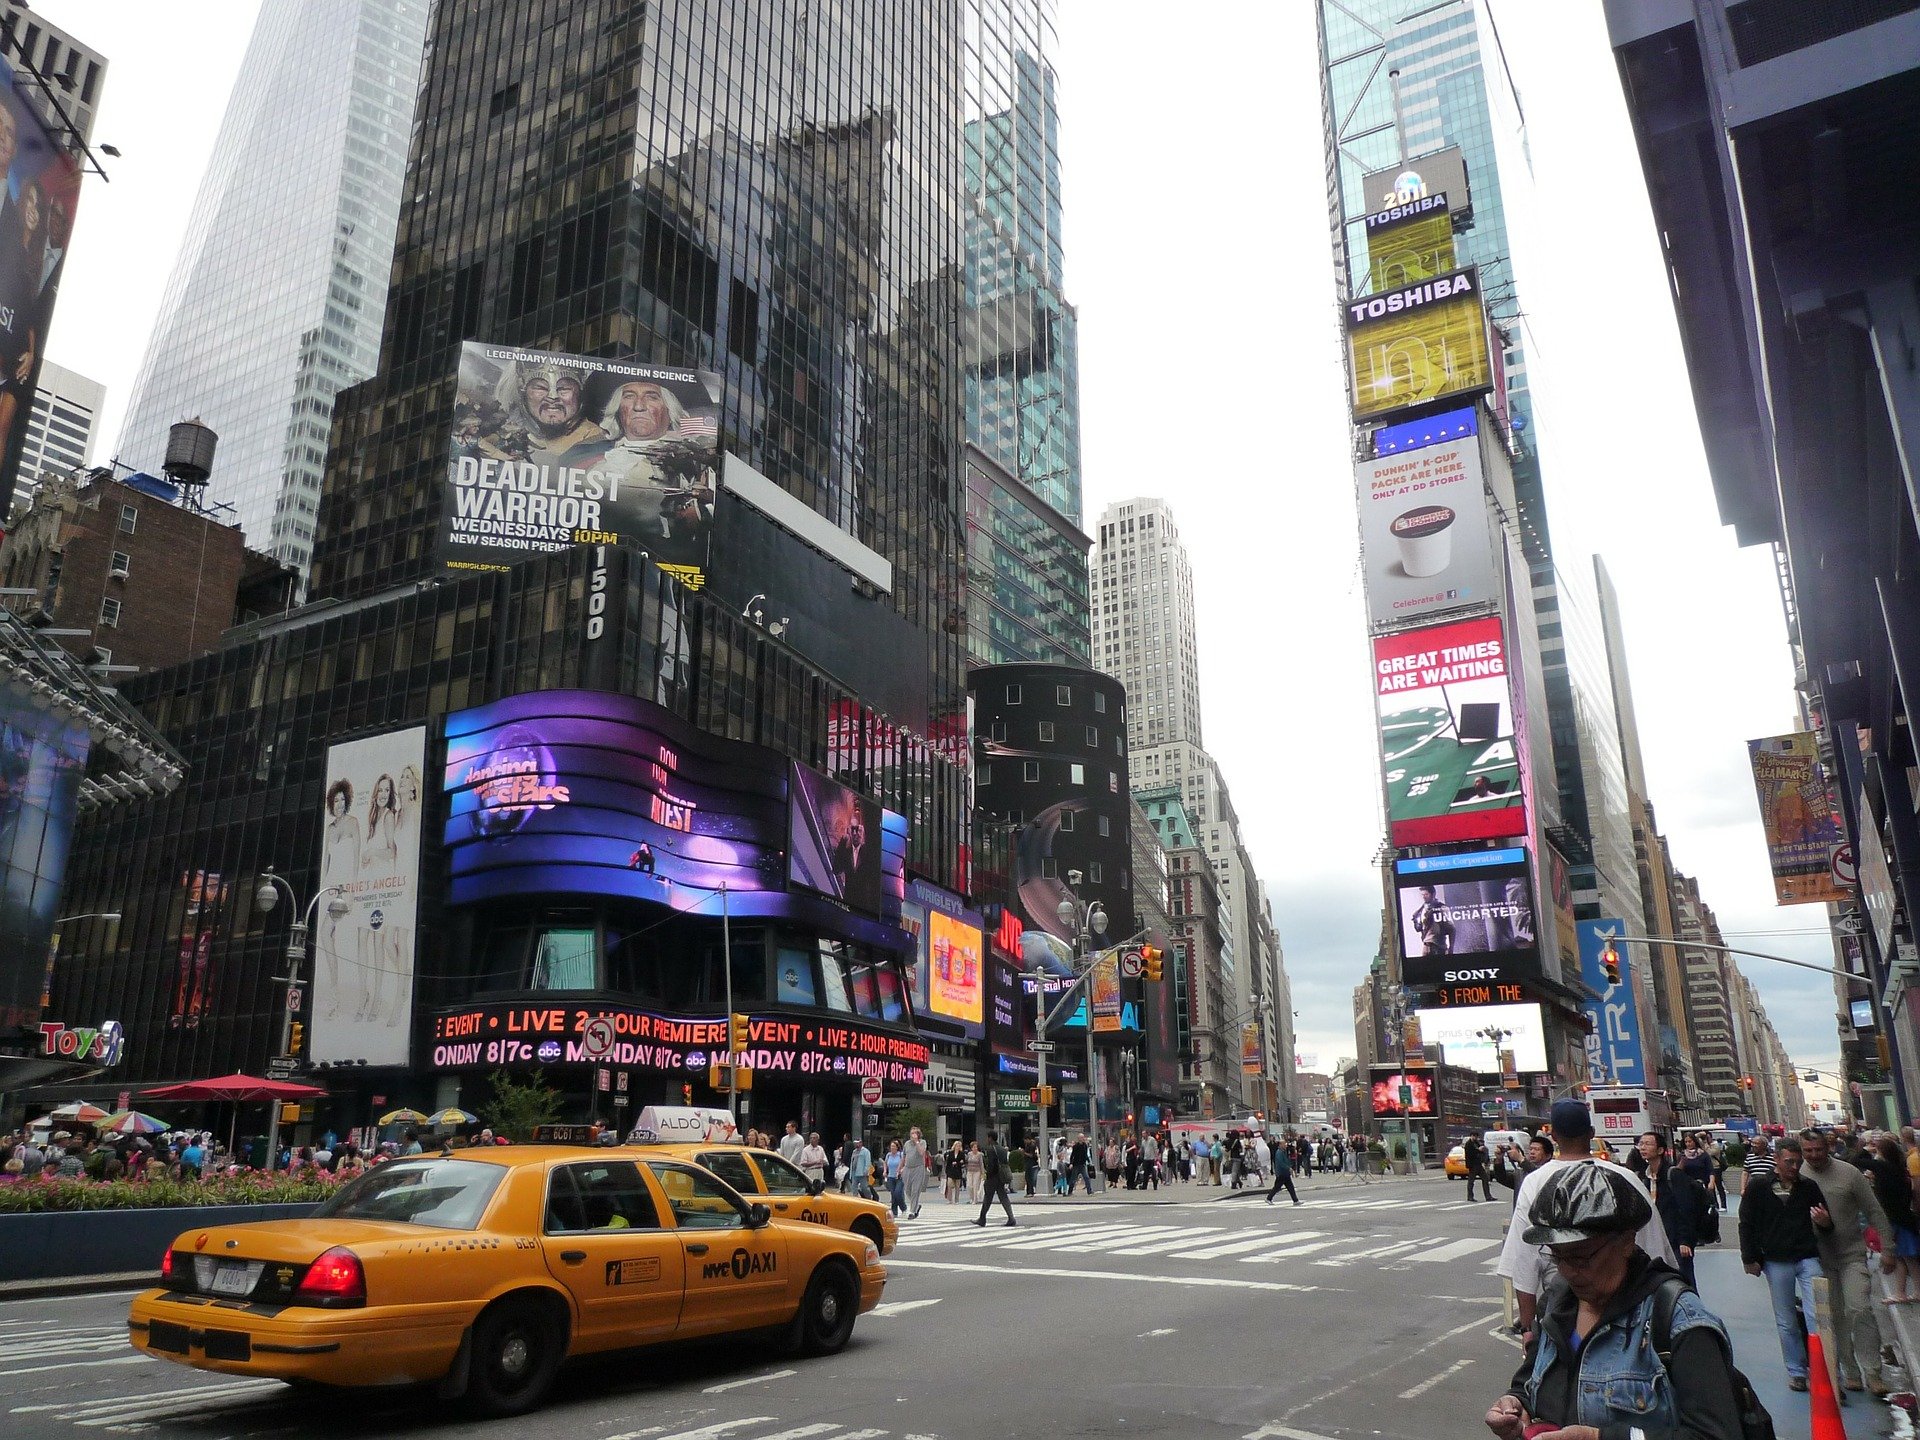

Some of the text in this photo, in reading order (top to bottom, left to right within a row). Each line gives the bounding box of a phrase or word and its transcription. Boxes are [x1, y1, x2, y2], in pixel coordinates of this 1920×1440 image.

[1366, 195, 1446, 228] TOSHIBA
[1350, 274, 1472, 323] TOSHIBA
[486, 349, 697, 384] LEGENDARY WARRIORS. MODERN SCIENCE.
[456, 456, 624, 502] DEADLIEST
[1371, 462, 1466, 490] PACKS ARE HERE.
[1374, 461, 1419, 479] DUNKIN'
[1372, 474, 1467, 500] ONLY AT DD STORES.
[455, 486, 601, 532] WARRIOR
[450, 532, 479, 545] NEW
[481, 536, 529, 551] SEASON
[451, 516, 618, 546] WEDNESDAYS 10PM
[586, 545, 607, 640] 1500
[1392, 596, 1434, 609] Celebrate
[1378, 640, 1501, 674] GREAT TIMES
[1380, 658, 1504, 692] ARE WAITING
[1756, 766, 1813, 781] FLEA MARKET
[498, 784, 570, 814] stars
[1429, 853, 1503, 868] News Corporation
[373, 876, 407, 890] ANGELS
[917, 884, 963, 915] WRIGLEY'S
[1433, 906, 1519, 923] UNCHARTED
[1000, 908, 1023, 959] JVC
[1027, 978, 1061, 994] Crstal
[1444, 968, 1500, 982] SONY
[1455, 986, 1490, 1004] FROM
[1497, 985, 1522, 1000] THE
[39, 1022, 105, 1060] Toys
[445, 1012, 483, 1038] EVENT
[508, 1010, 565, 1031] LIVE
[598, 1011, 650, 1036] OUR
[653, 1019, 727, 1043] PREMIERE
[745, 1019, 800, 1044] VENT
[819, 1027, 848, 1048] LIVE
[850, 1031, 857, 1049] 2
[860, 1033, 887, 1056] HOUR
[888, 1038, 924, 1062] PREMIERE
[434, 1040, 482, 1067] ONDAY
[538, 1044, 561, 1057] abc
[566, 1041, 654, 1064] MNDAY
[686, 1054, 706, 1067] abc
[833, 1060, 846, 1070] abc
[847, 1056, 889, 1079] MONDAY
[1004, 1100, 1030, 1108] COFFEE
[553, 1127, 573, 1140] 6C61
[660, 1117, 701, 1131] ALDO
[801, 1208, 829, 1226] TAXI
[514, 1236, 539, 1250] 6C61
[703, 1247, 777, 1280] NYC TAXI
